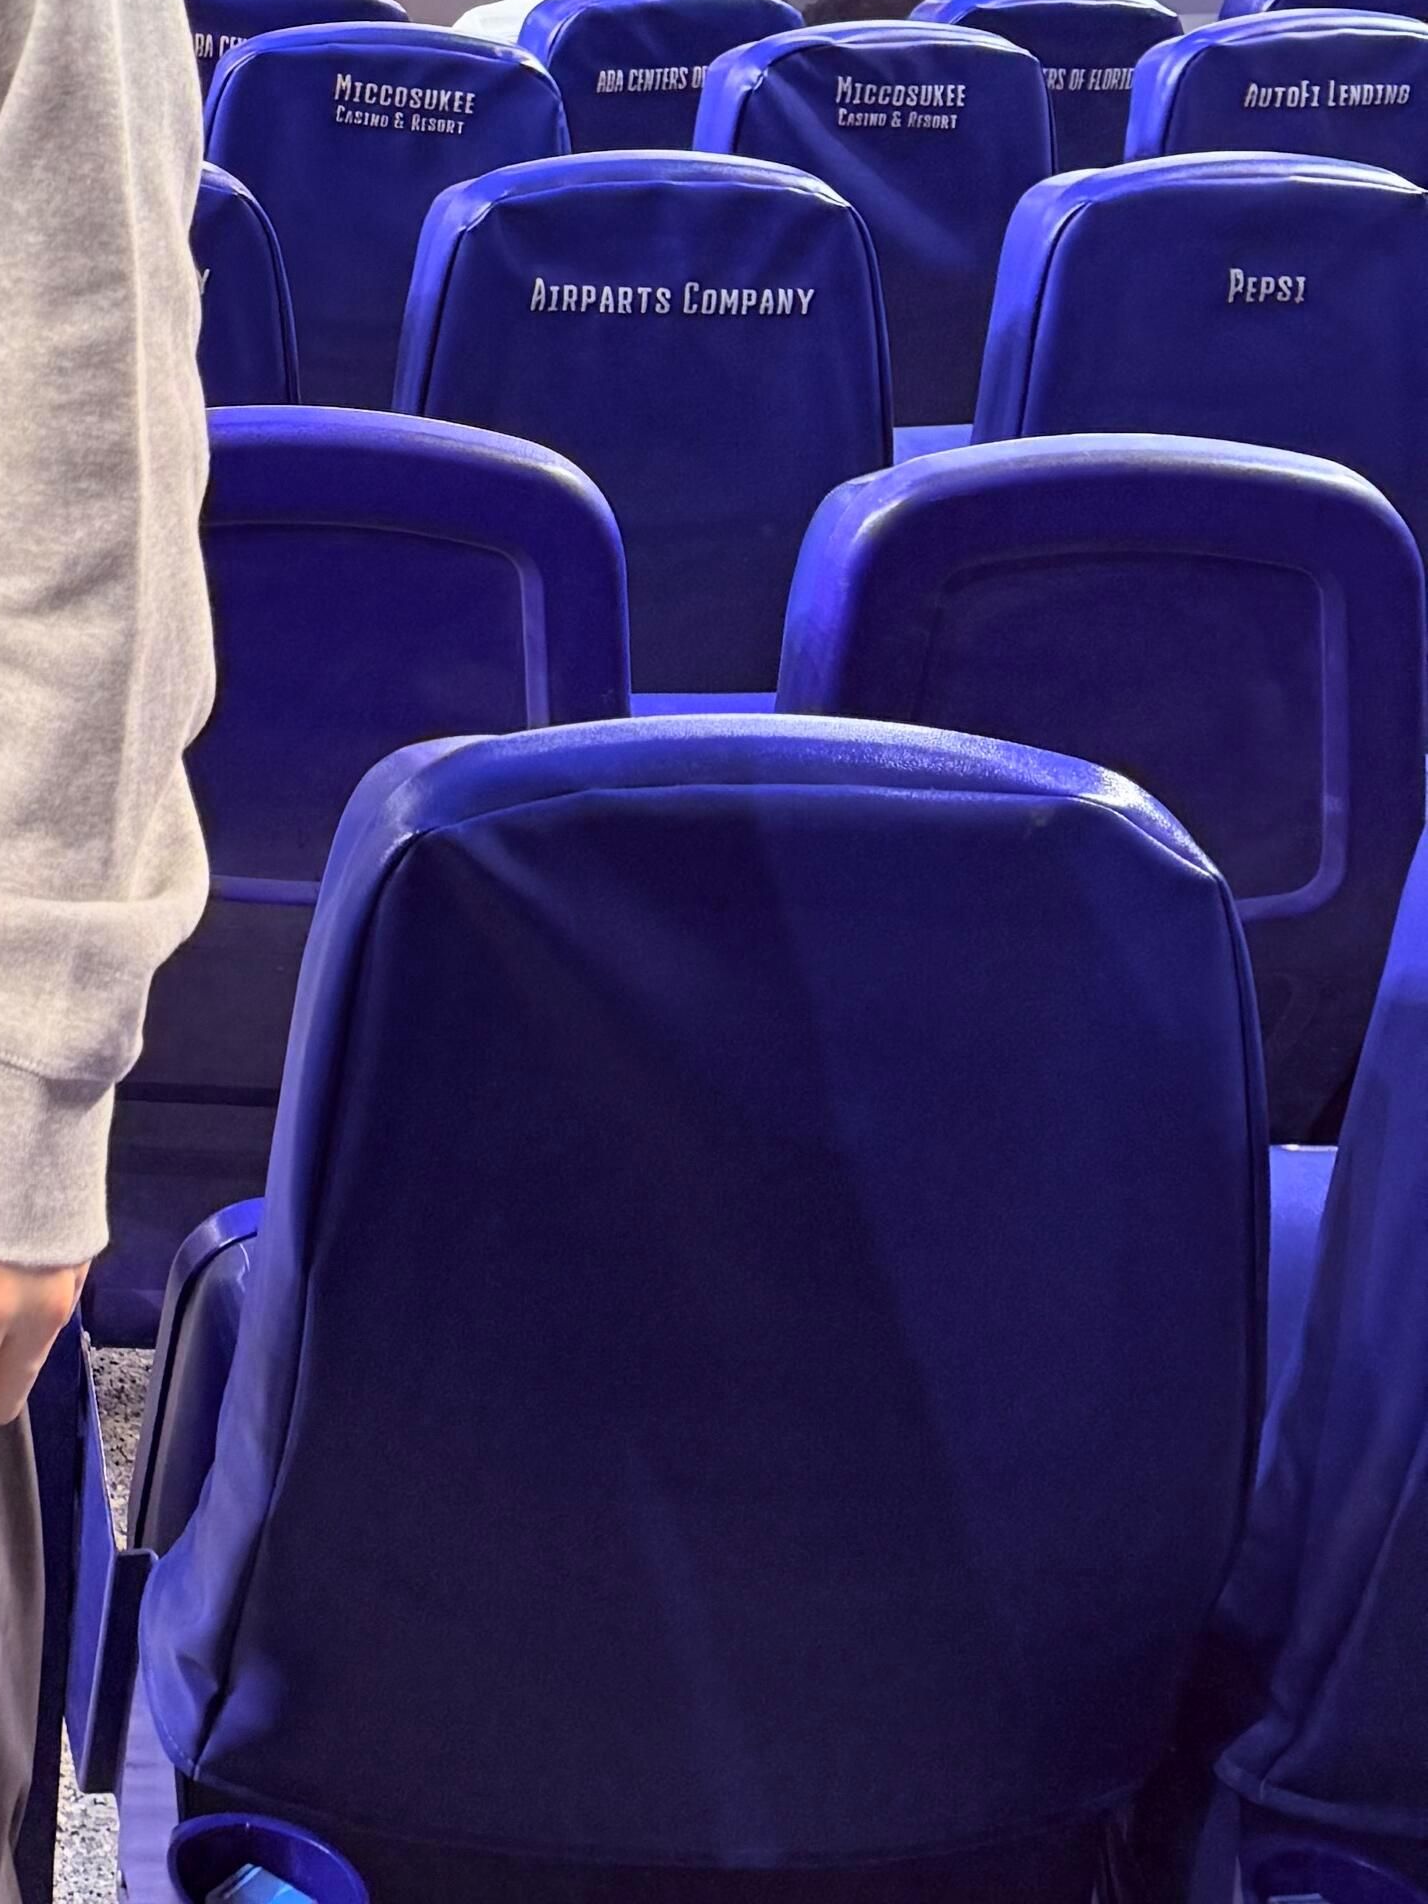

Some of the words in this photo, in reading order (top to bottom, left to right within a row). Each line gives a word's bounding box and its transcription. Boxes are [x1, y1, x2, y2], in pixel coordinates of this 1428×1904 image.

[627, 66, 689, 92] CENTERS
[394, 111, 404, 129] &
[891, 111, 902, 128] &
